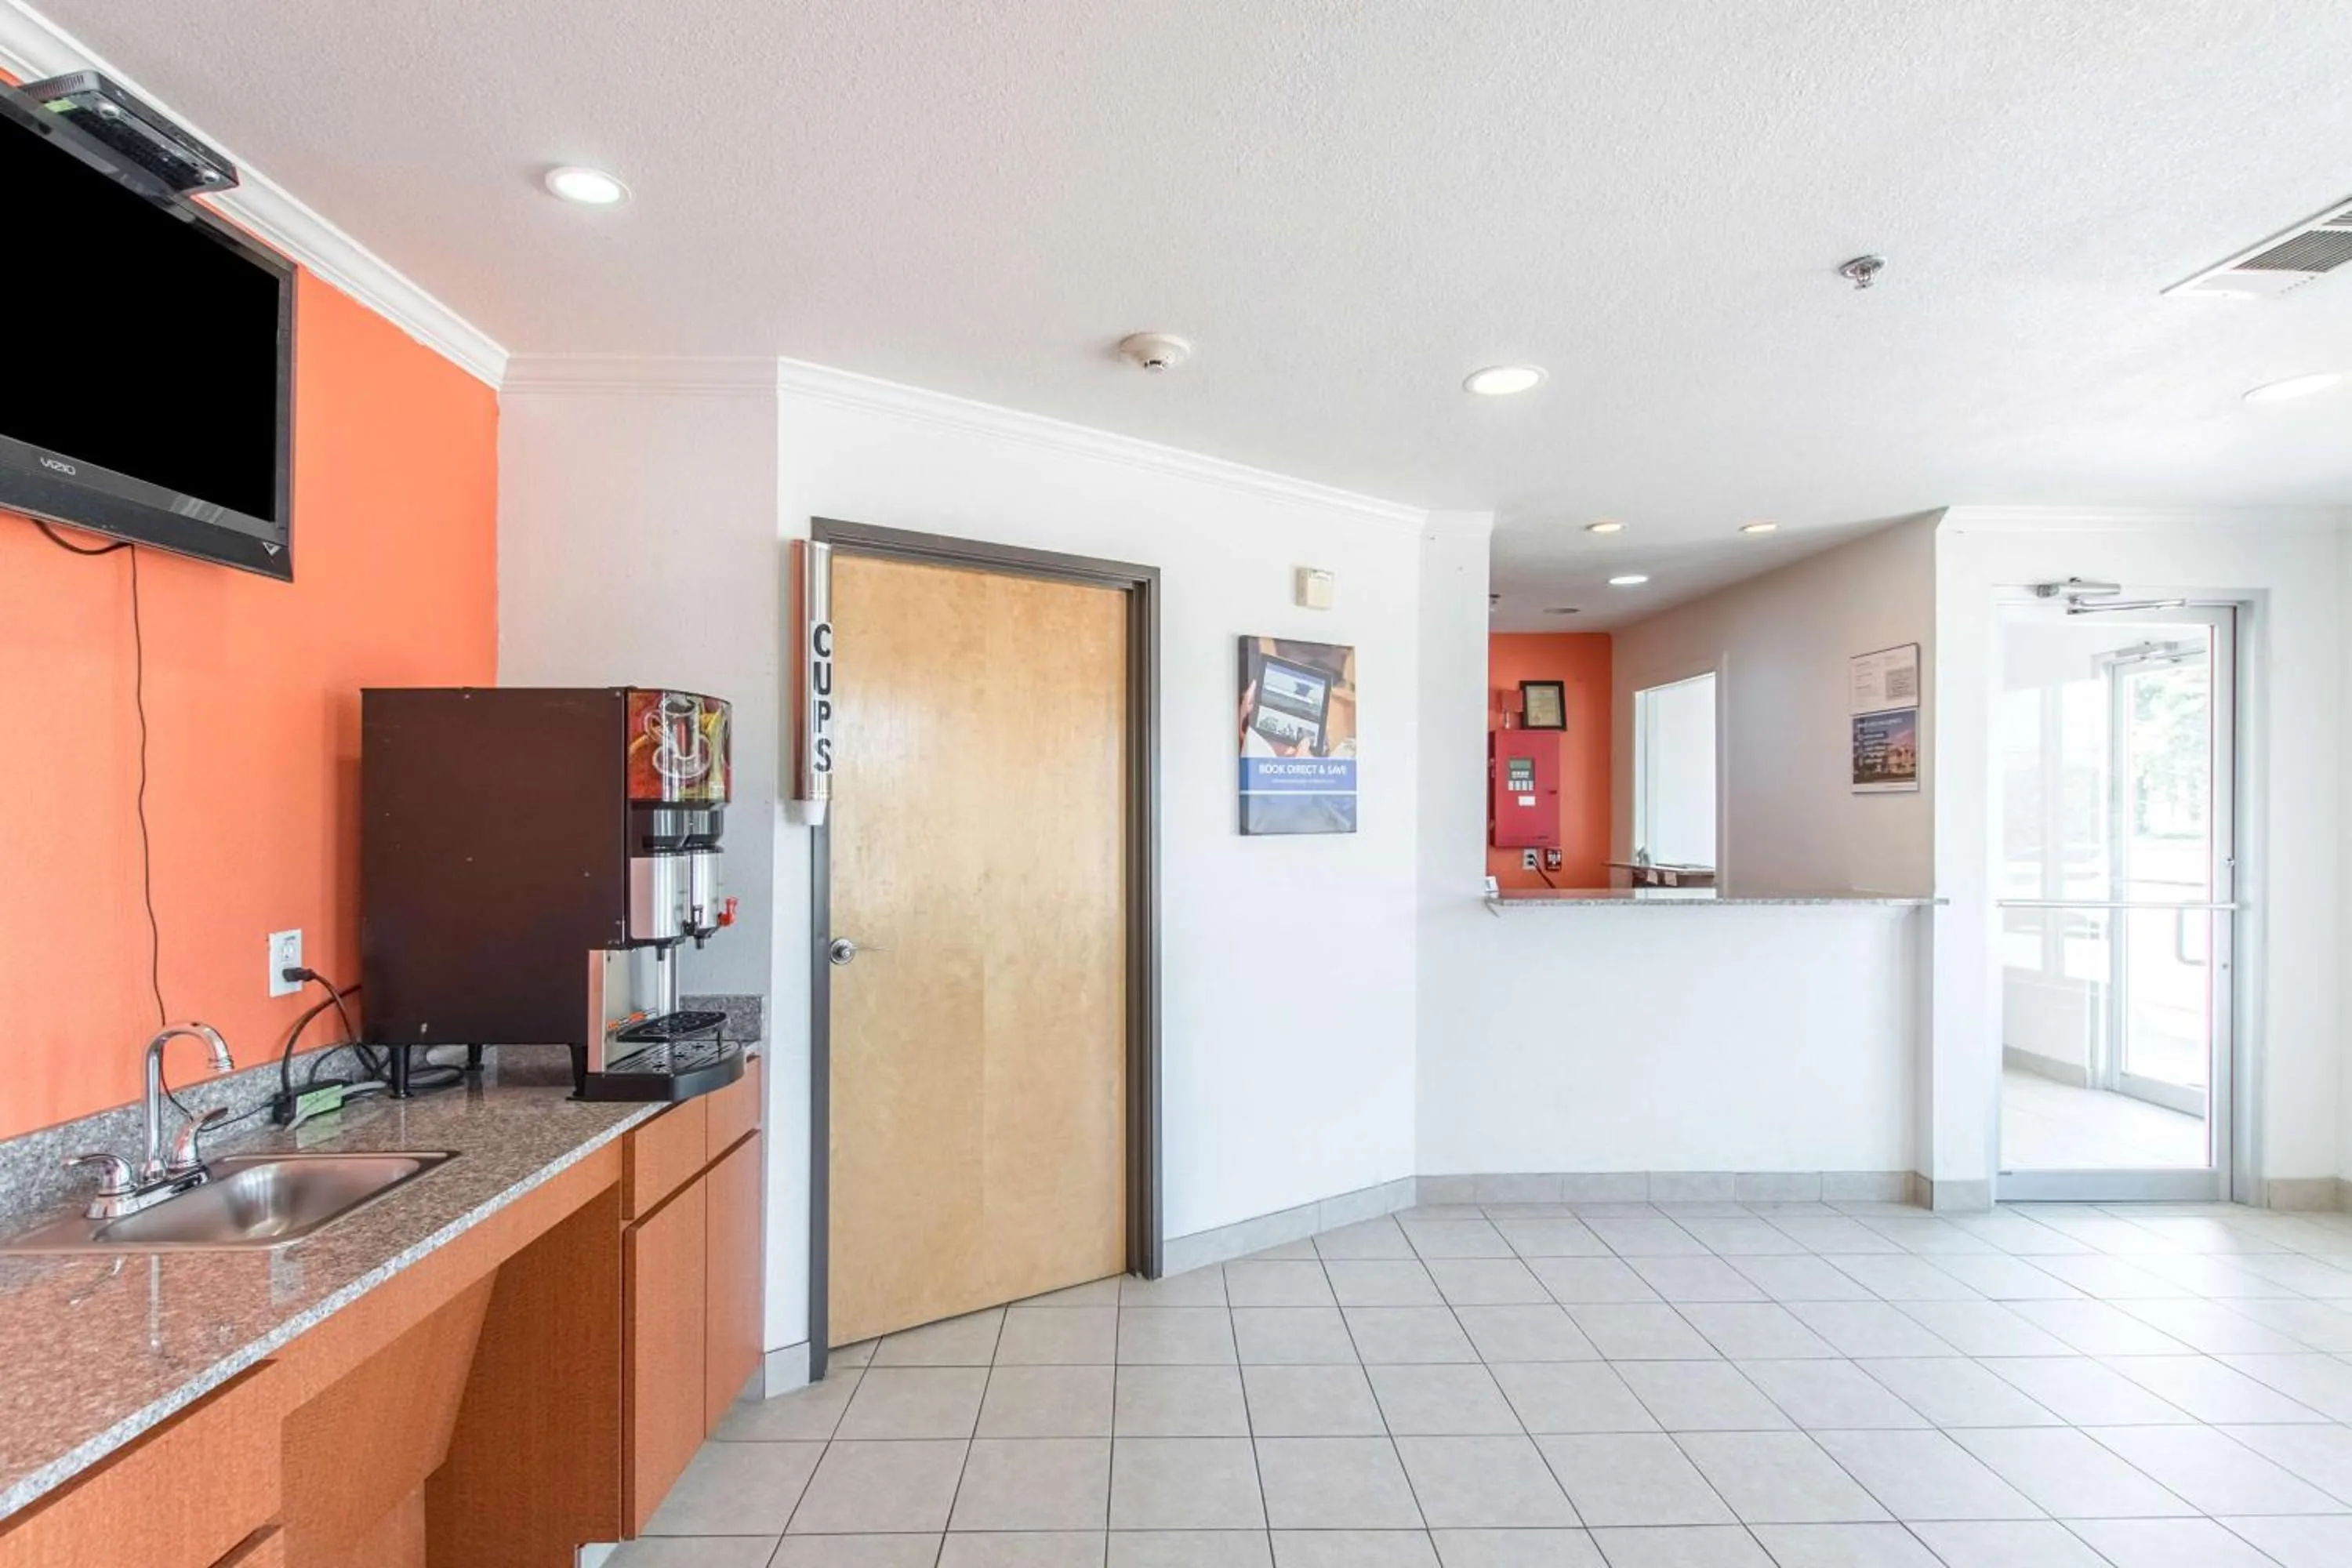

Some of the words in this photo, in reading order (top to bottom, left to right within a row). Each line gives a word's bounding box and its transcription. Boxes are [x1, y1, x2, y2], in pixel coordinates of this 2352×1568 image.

[40, 457, 76, 476] VIZIO
[813, 623, 832, 773] CUPS
[1258, 764, 1286, 775] BOOK
[1287, 764, 1318, 775] DIRECT
